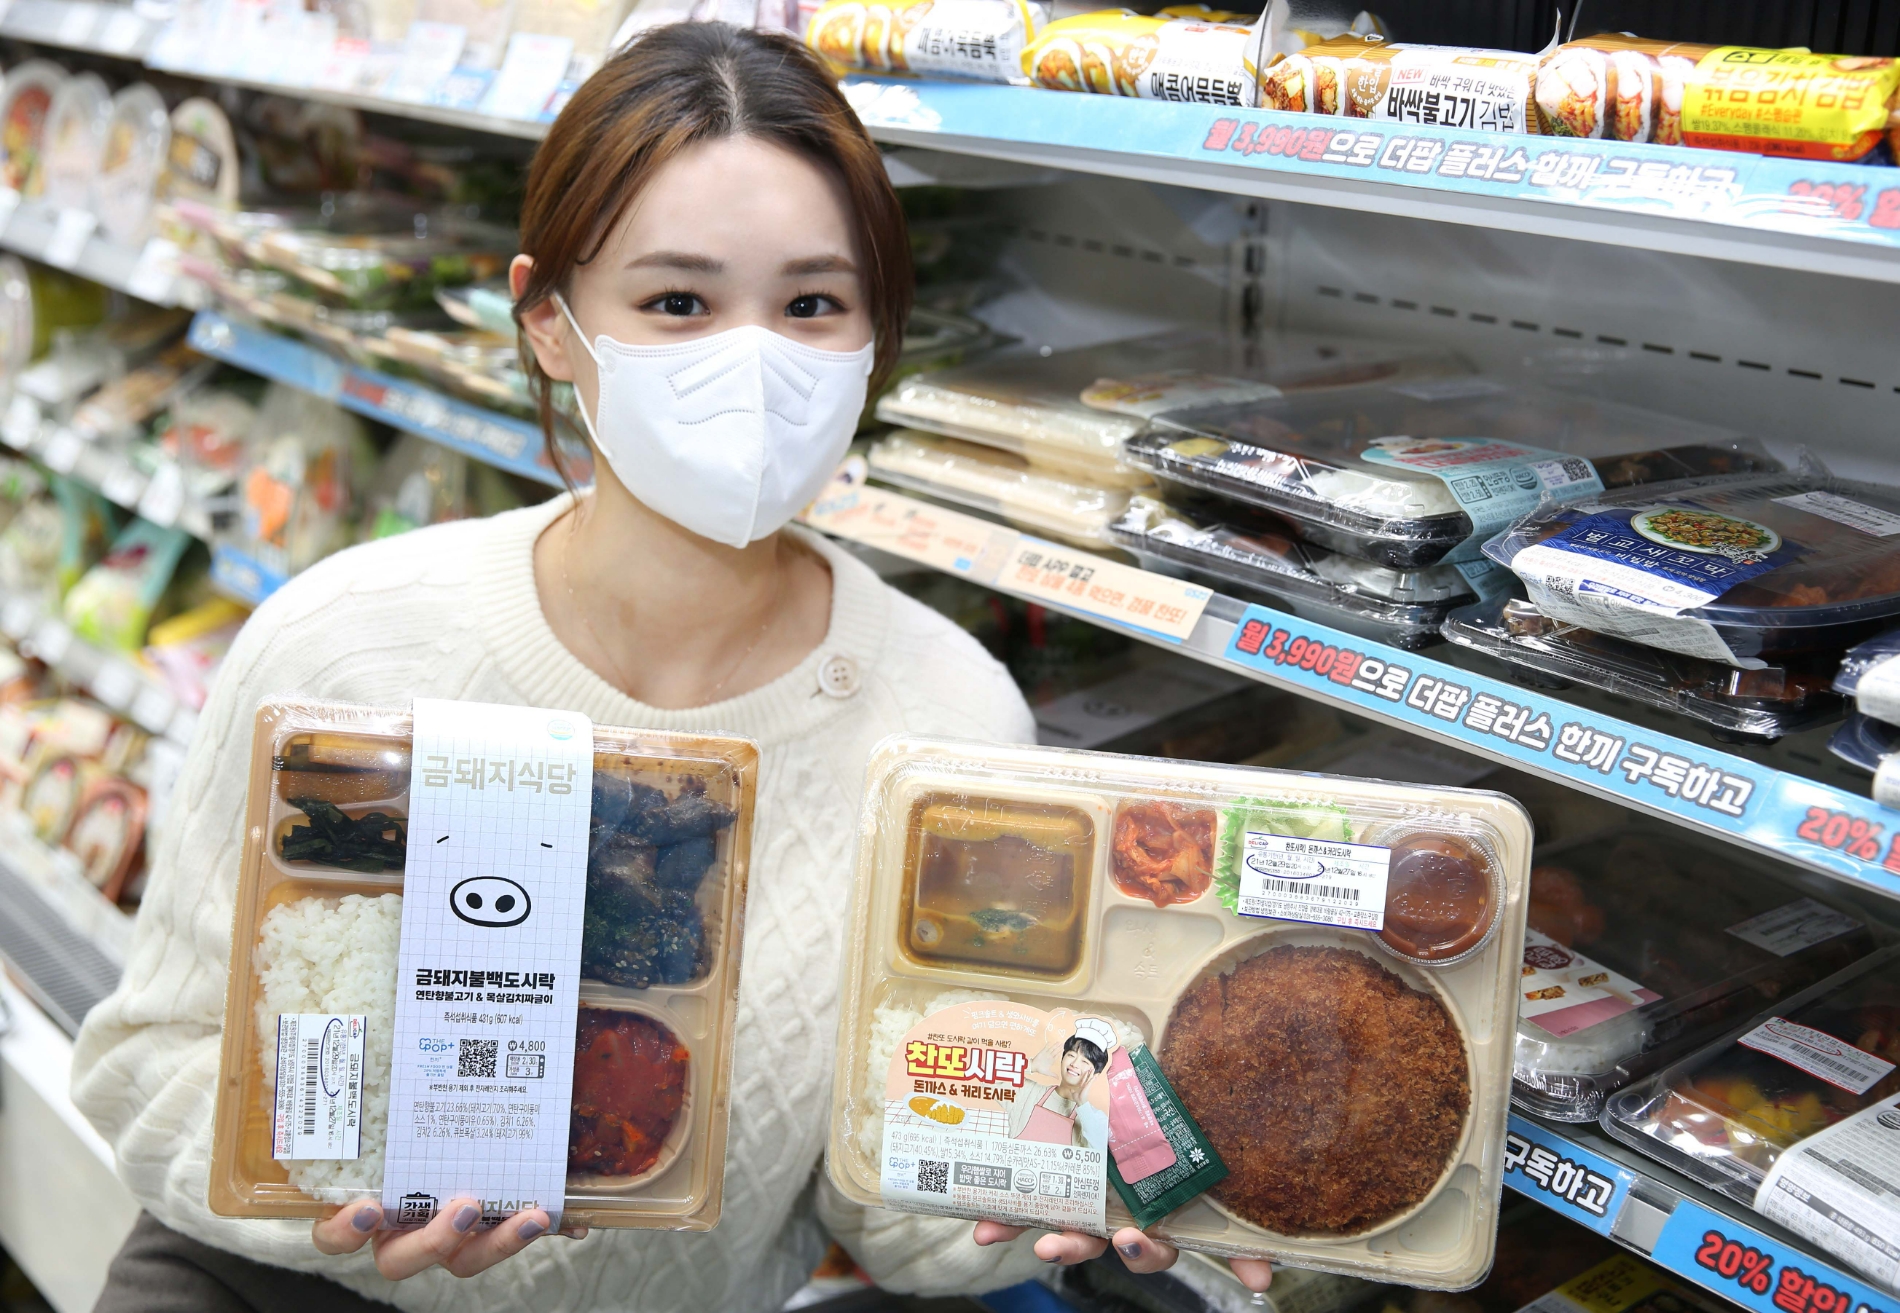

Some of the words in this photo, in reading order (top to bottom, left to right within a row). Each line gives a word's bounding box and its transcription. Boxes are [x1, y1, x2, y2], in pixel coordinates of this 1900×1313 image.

[1397, 69, 1424, 80] NEW
[1430, 74, 1452, 89] 바싹
[1453, 77, 1473, 94] 구워
[1474, 80, 1486, 94] 더
[1387, 87, 1476, 129] 바싹불고기
[1204, 118, 1237, 152] 월
[1232, 122, 1383, 168] 3,990원으로
[1378, 136, 1445, 174] 더팝
[1438, 141, 1529, 185] 플러스
[1615, 551, 1660, 569] 비빔밥
[1185, 588, 1210, 601] GS25
[1236, 619, 1270, 654] 월
[1265, 629, 1411, 701] 3,990원으로
[1406, 676, 1470, 722] 더팝
[1464, 692, 1552, 751] 플러스
[1554, 723, 1624, 774] 한끼
[1621, 744, 1754, 816] 구독하고
[422, 756, 577, 795] 금돼지식당
[1797, 806, 1882, 861] 20%
[416, 969, 555, 990] 금돼지불백도시락
[416, 990, 473, 1002] 연탄향불고기
[476, 993, 484, 1002] &
[486, 993, 553, 1004] 목살김치짜글이
[444, 1012, 478, 1023] 즉석섭취식품
[479, 1013, 494, 1025] 431g
[947, 1035, 965, 1043] 도시락
[967, 1037, 980, 1045] 같이
[981, 1038, 993, 1047] 먹을
[995, 1040, 1012, 1049] 사람?
[906, 1041, 1027, 1087] 찬또시락
[347, 1053, 359, 1127] 금돼지불백도시락
[914, 1080, 946, 1095] 돈까스
[949, 1083, 957, 1096] &
[961, 1164, 992, 1177] 우리햅쌀로
[993, 1168, 1006, 1178] 지어
[1017, 1175, 1035, 1184] HACCP
[1505, 1134, 1613, 1215] 구독하고
[959, 1174, 973, 1184] 밥맛
[974, 1176, 987, 1187] 좋은
[988, 1177, 1008, 1189] 도시락
[1074, 1176, 1100, 1192] 안심뚜껑
[1778, 1177, 1812, 1203] 영양정보
[1696, 1232, 1771, 1292] 20%
